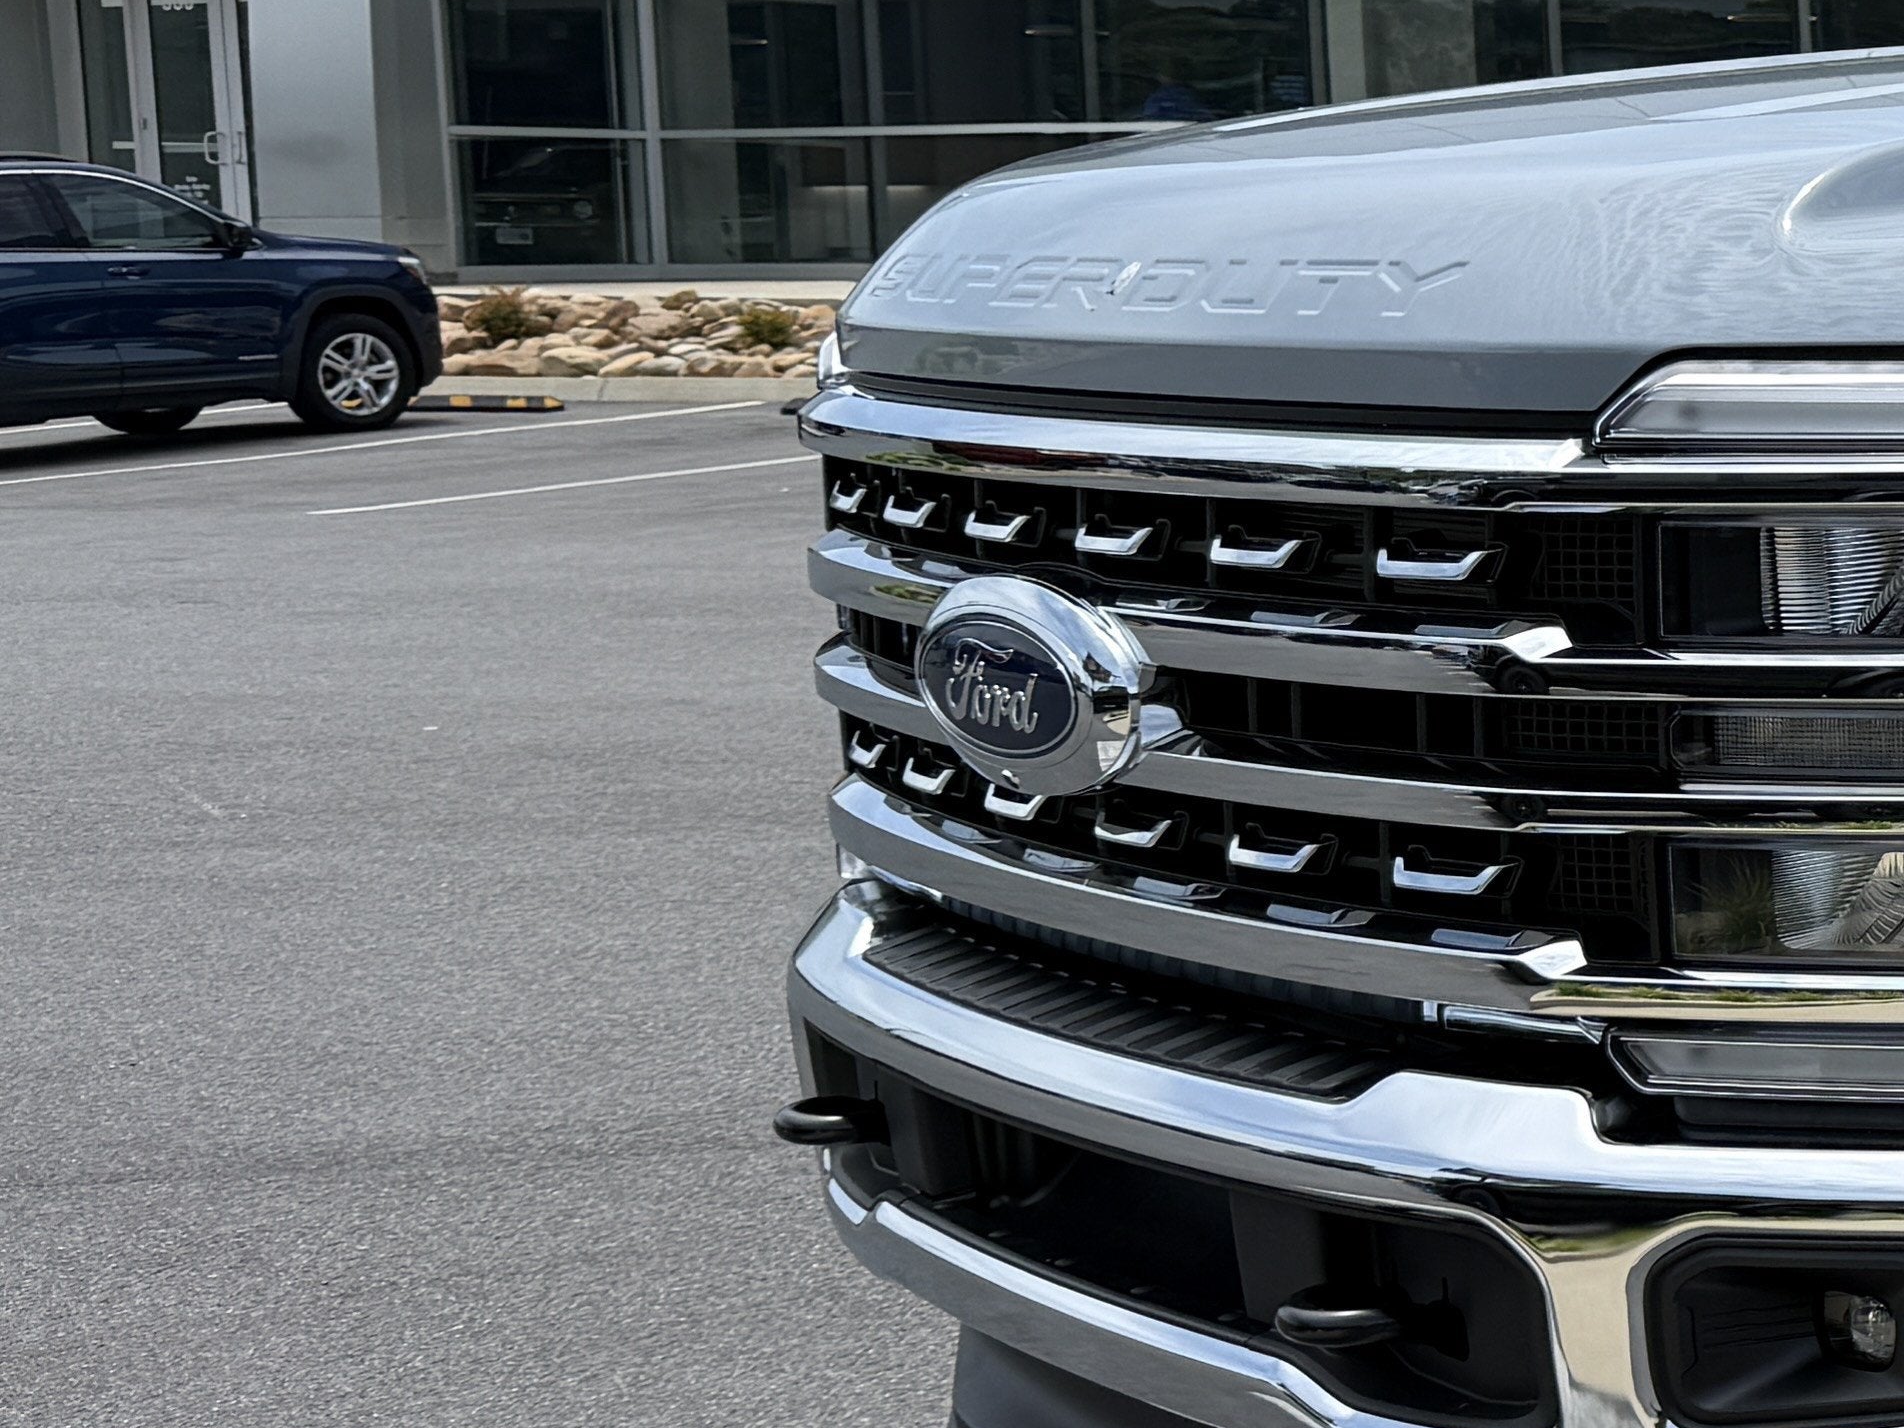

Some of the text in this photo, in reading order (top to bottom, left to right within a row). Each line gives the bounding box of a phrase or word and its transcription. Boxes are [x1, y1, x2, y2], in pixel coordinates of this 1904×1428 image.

[868, 253, 1472, 319] SUPER DUTY
[945, 638, 1039, 734] Ford
